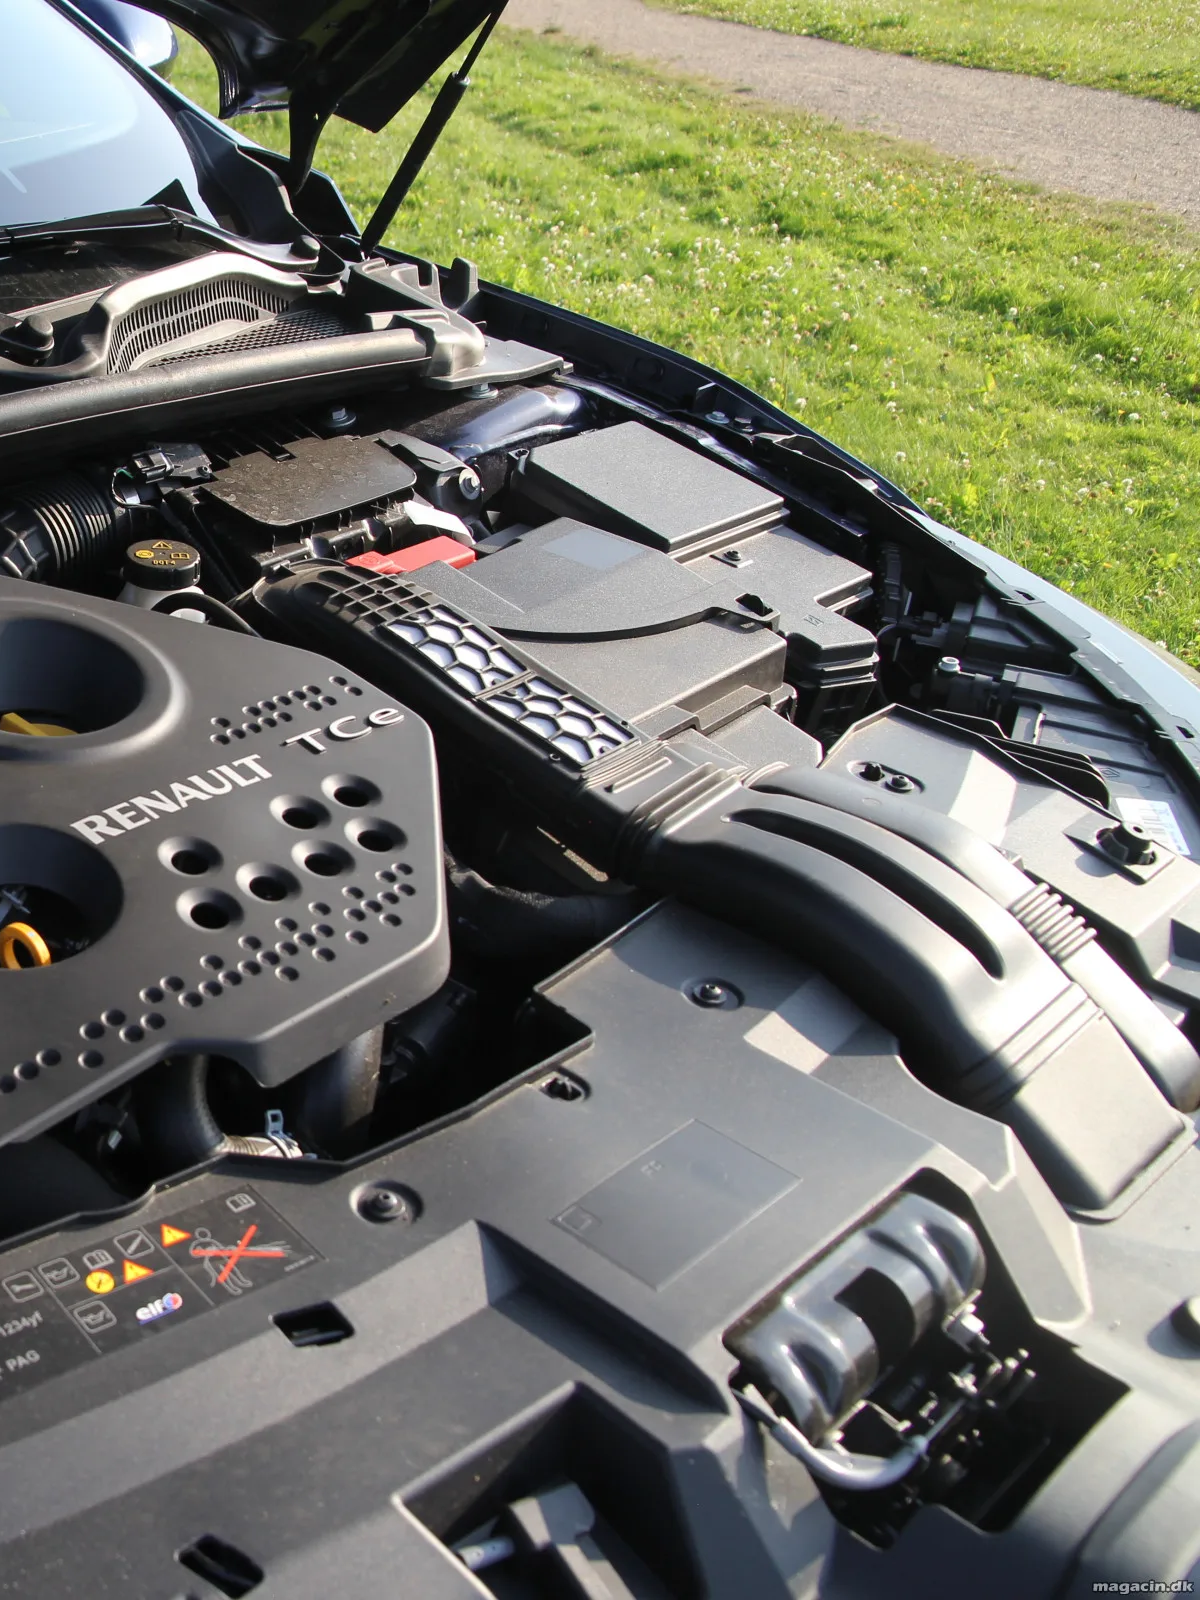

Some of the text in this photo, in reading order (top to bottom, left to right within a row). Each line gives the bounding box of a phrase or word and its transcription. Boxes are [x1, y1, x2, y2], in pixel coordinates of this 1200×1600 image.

[69, 706, 405, 845] RENAULT TCe
[135, 1296, 173, 1323] elf
[5, 1349, 41, 1372] PAG
